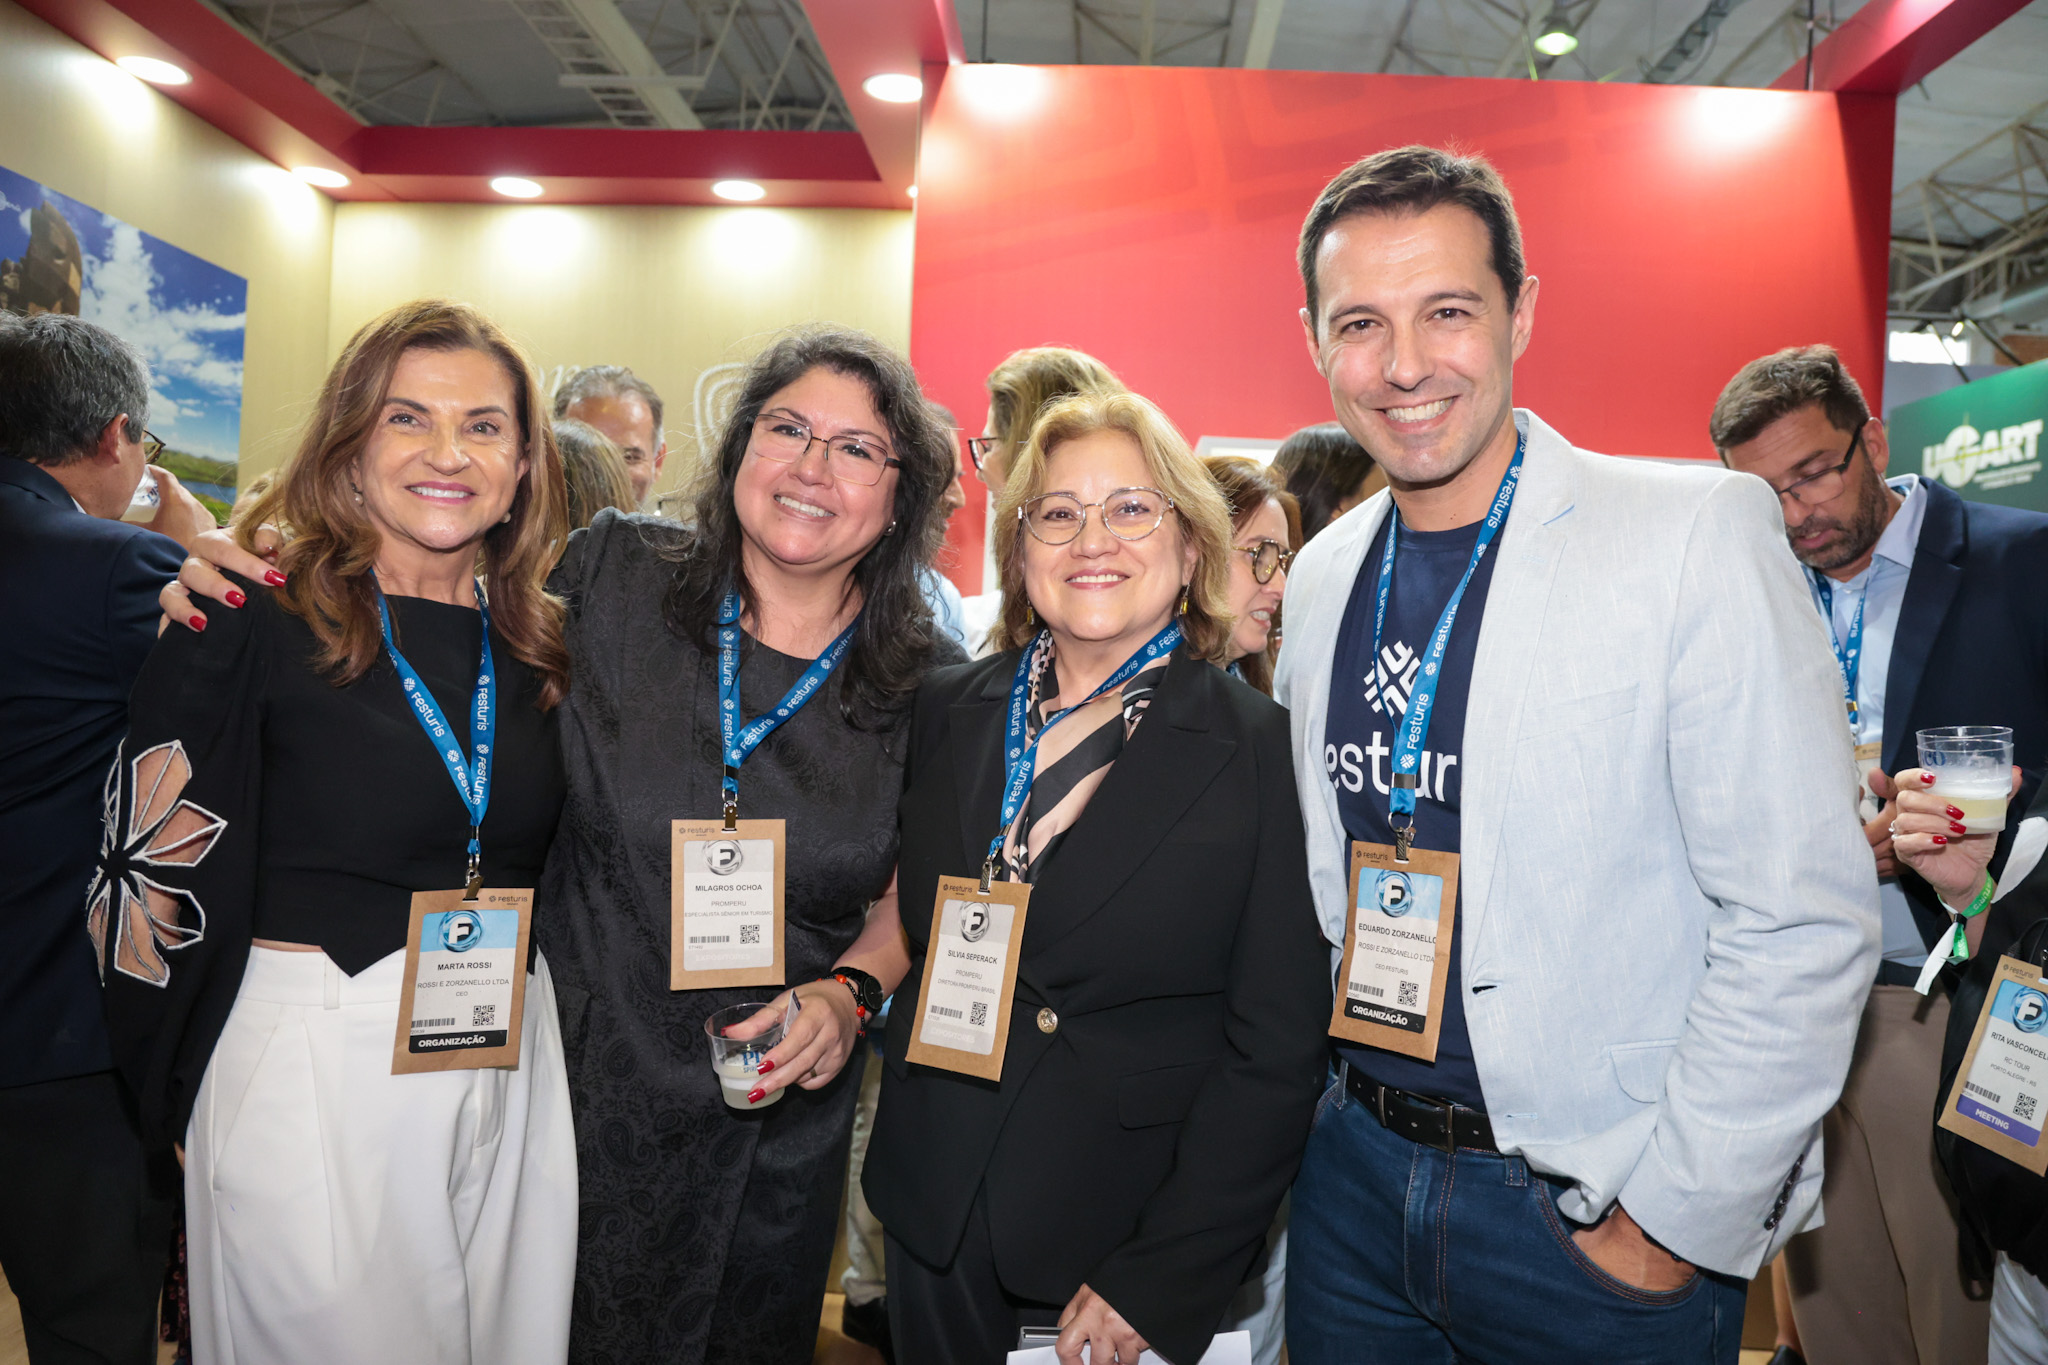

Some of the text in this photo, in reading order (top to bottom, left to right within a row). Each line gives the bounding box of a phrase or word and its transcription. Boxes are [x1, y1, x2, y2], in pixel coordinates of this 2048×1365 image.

[1922, 419, 2044, 488] UGART
[1487, 479, 1515, 529] Festuris
[1158, 627, 1180, 649] Festu
[1433, 604, 1458, 658] Festuris
[723, 644, 735, 686] Festuris
[1102, 660, 1139, 692] Festuris
[786, 676, 818, 709] Festuris
[411, 692, 445, 737] Festuris
[476, 688, 488, 731] Festuris
[1010, 697, 1022, 736] Festuris
[1407, 693, 1429, 750] Festuris
[740, 718, 775, 750] Festuris
[1325, 731, 1457, 802] estur
[473, 756, 487, 805] Festuris
[1009, 760, 1031, 802] Festuris
[498, 895, 528, 903] Festuris
[695, 884, 734, 892] MILAGROS
[1358, 922, 1390, 936] EDUARDO
[947, 949, 998, 965] SILVIA SEPERACK
[1358, 941, 1375, 951] ROSSI
[1380, 946, 1419, 960] ZORZANELLO
[1419, 954, 1435, 963] LTDA
[437, 962, 465, 971] MARTA
[955, 969, 982, 980] PROMPERU
[1385, 965, 1409, 975] FESTURIS
[417, 981, 438, 989] ROSSI
[445, 979, 491, 987] ZORZANELLO
[1352, 1004, 1408, 1026] ORGANIZAÇÃO
[418, 1034, 486, 1048] ORGANIZAÇÃO
[1990, 1031, 2048, 1060] RITA VASCONCEL
[1990, 1063, 2006, 1074] PORTO
[2006, 1070, 2026, 1083] ALEGRE
[2004, 1056, 2031, 1072] RC TOUR
[1975, 1108, 2009, 1130] MEETING
